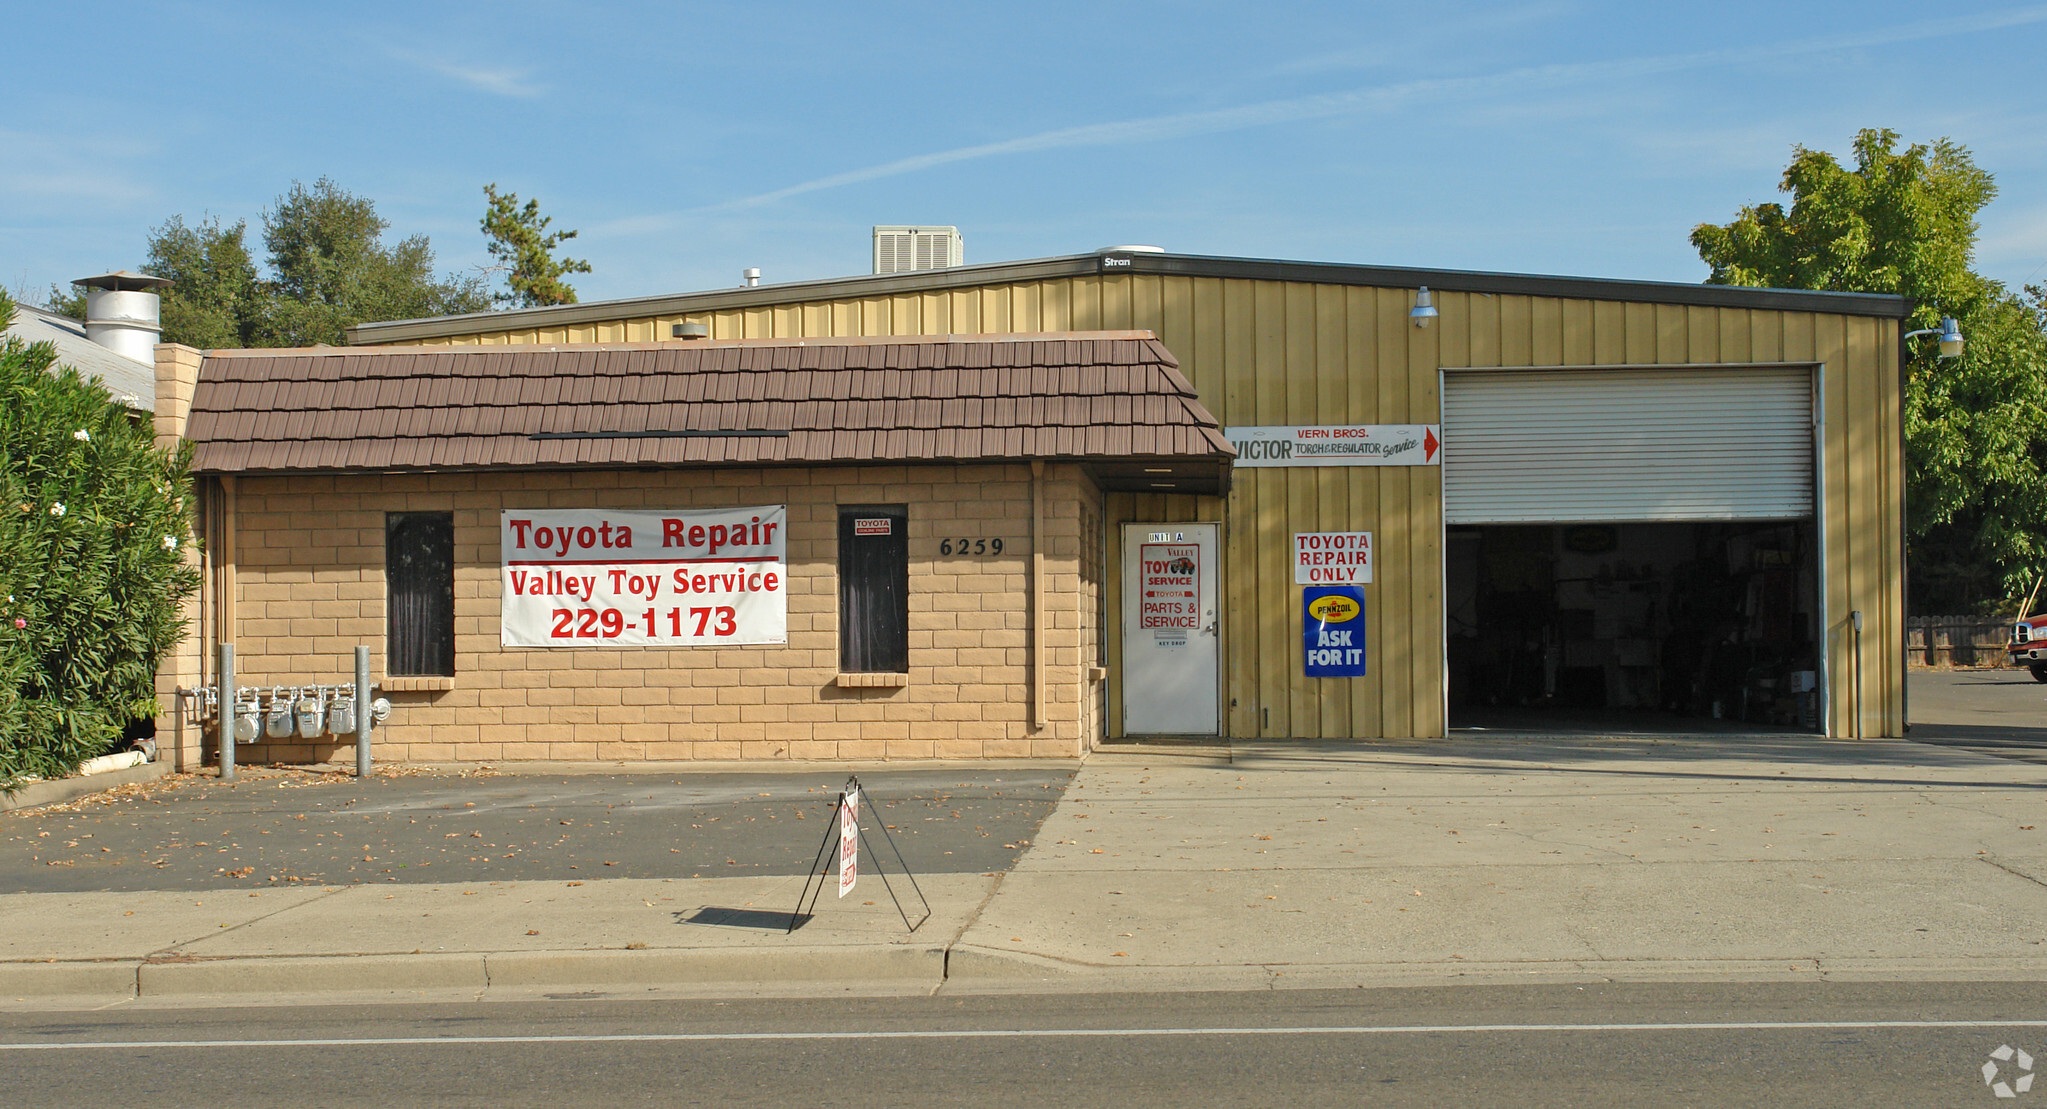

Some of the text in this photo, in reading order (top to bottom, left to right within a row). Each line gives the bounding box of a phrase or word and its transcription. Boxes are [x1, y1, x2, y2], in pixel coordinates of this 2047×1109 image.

[1104, 257, 1130, 266] Stran
[1298, 428, 1369, 438] VERN BROS.
[1232, 440, 1292, 459] VICTOR
[1295, 443, 1324, 454] TORCH
[1331, 443, 1381, 454] REGULATOR
[1383, 438, 1419, 458] Service
[856, 519, 889, 527] TOYOTA
[510, 516, 778, 557] Toyota Repair
[1149, 533, 1183, 541] UNIT A
[1297, 535, 1369, 549] TOYOTA
[940, 538, 1003, 556] 6259
[1167, 548, 1194, 557] VALLEY
[1300, 551, 1367, 565] REPAIR
[1145, 560, 1171, 574] TOY
[1309, 567, 1357, 581] ONLY
[510, 567, 779, 602] Valley Toy Service
[1148, 577, 1192, 585] SERVICE
[1145, 602, 1196, 613] PARTS &
[1317, 603, 1352, 614] PENNZOIL
[550, 606, 737, 638] 229-1173
[1145, 616, 1196, 628] SERVICE
[1317, 631, 1352, 647] ASK
[1308, 649, 1362, 666] FOR IT
